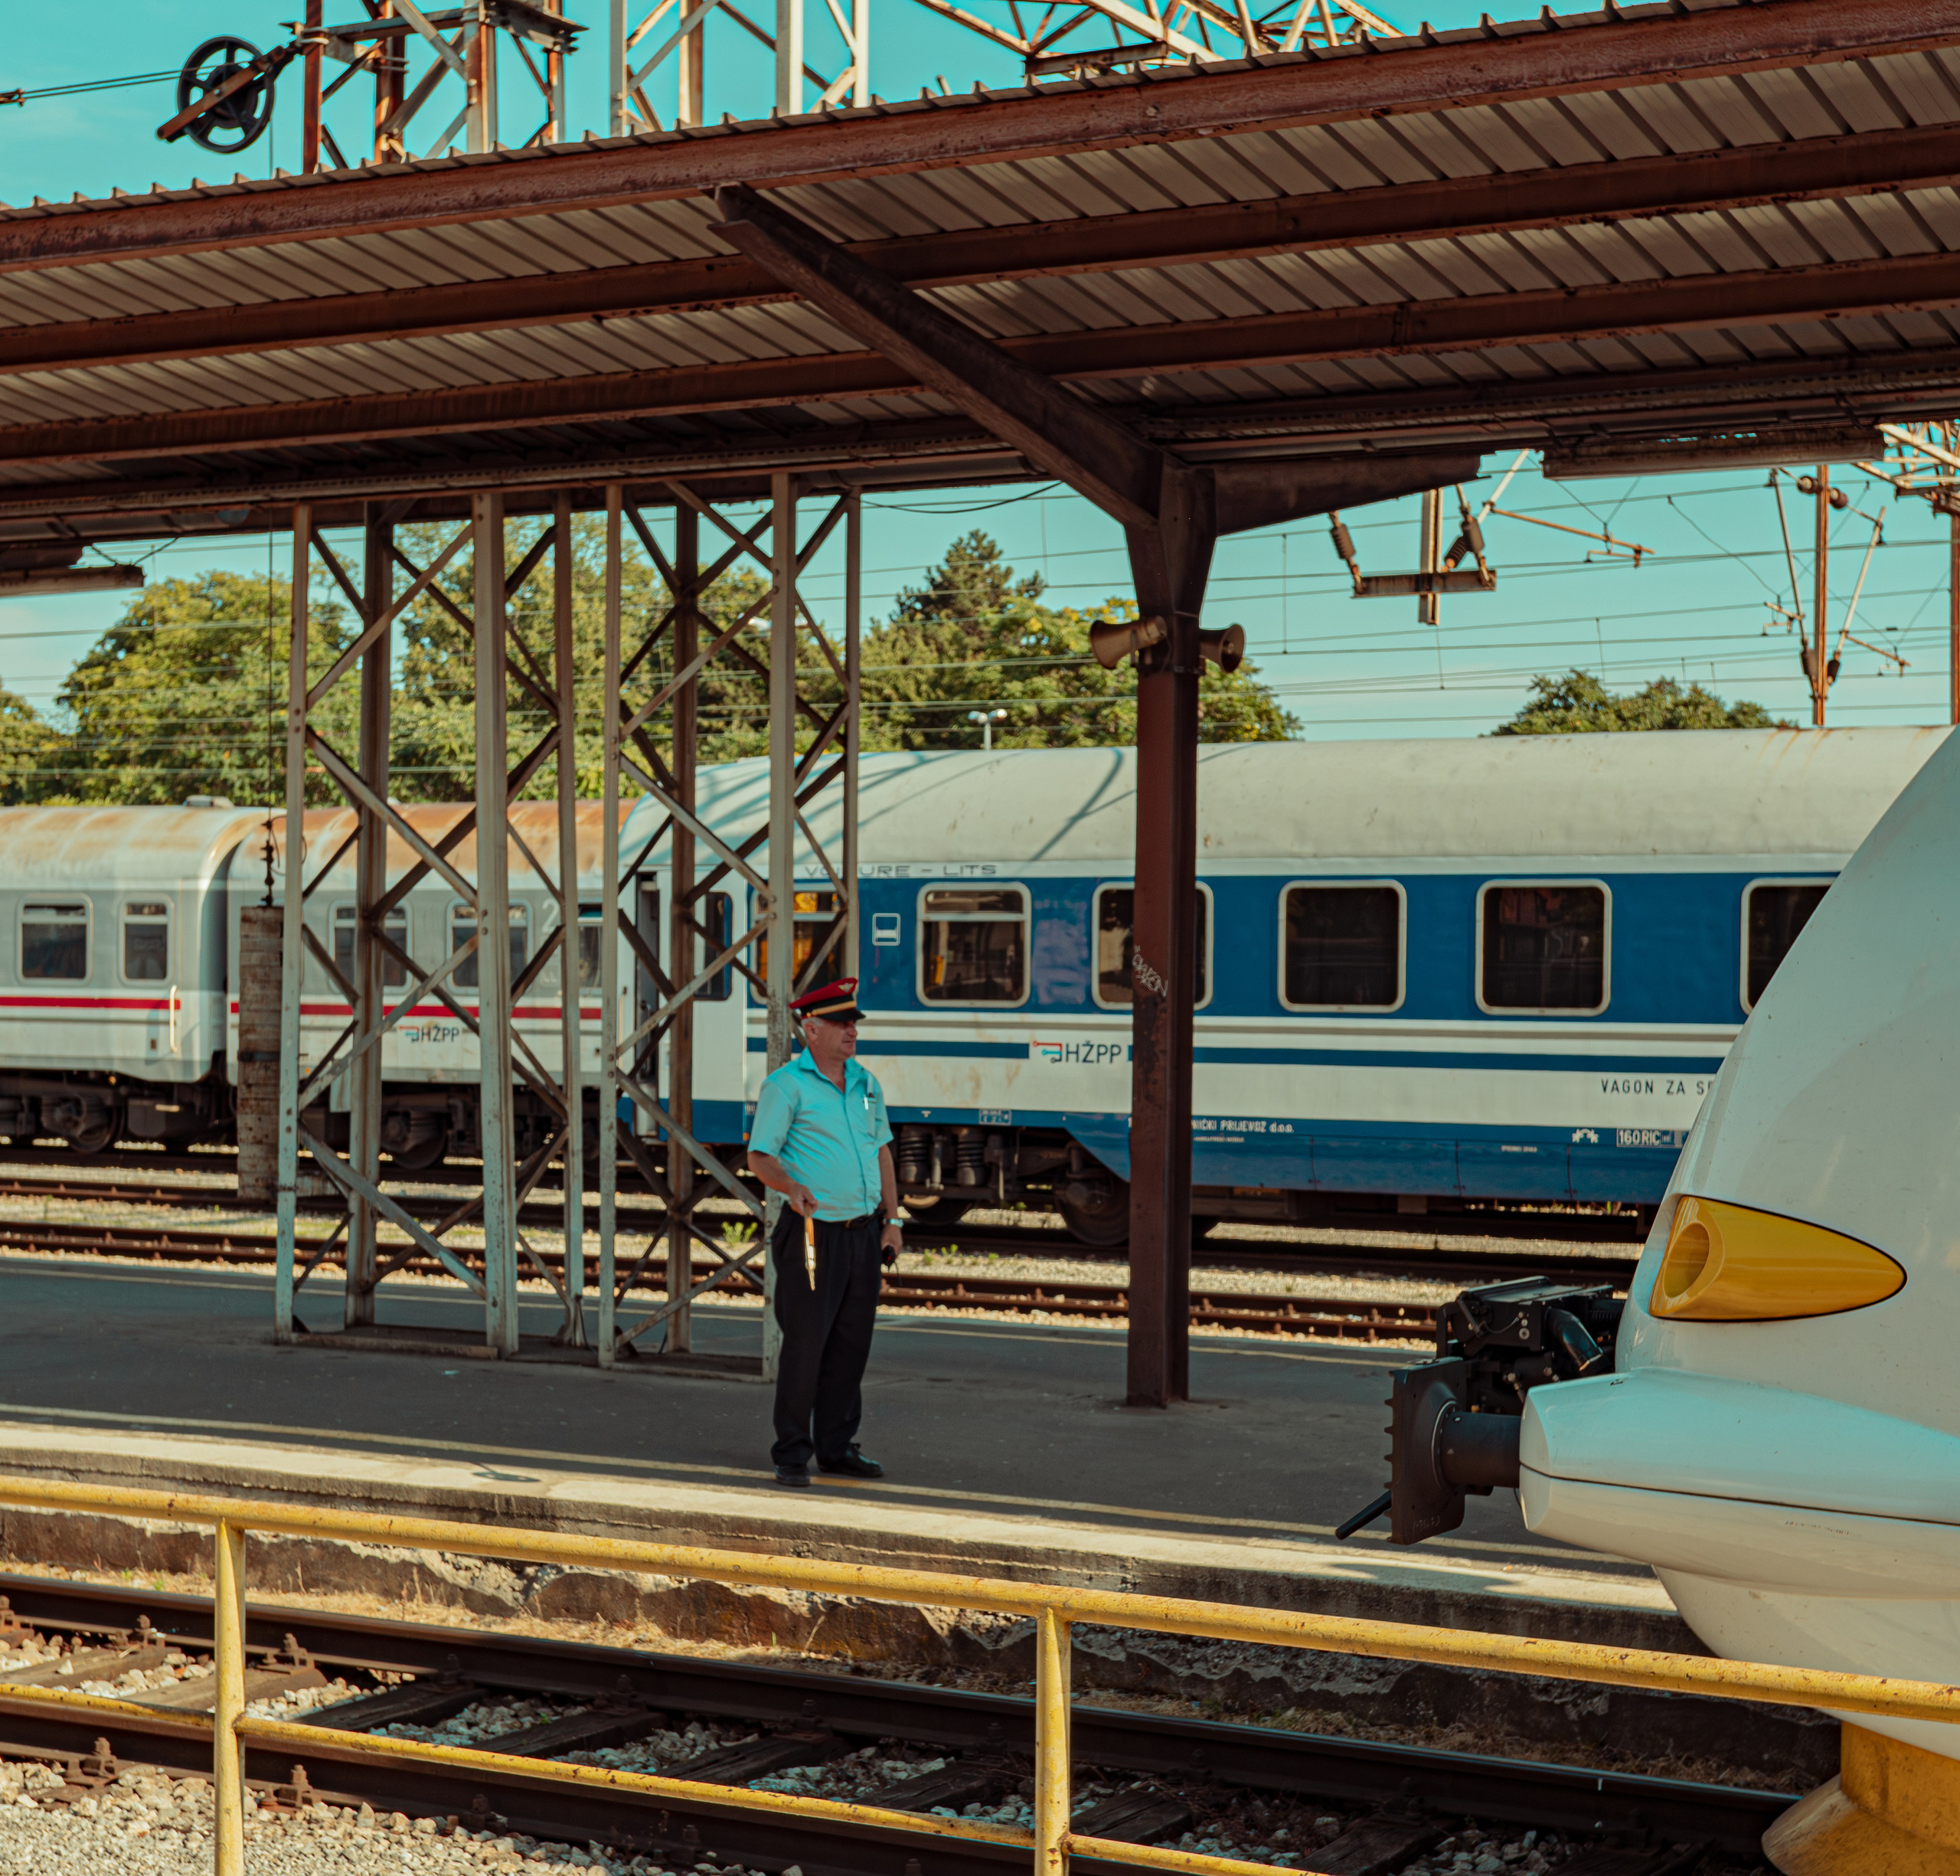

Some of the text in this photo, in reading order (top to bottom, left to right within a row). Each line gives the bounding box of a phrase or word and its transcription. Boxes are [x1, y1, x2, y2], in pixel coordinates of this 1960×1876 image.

[805, 865, 910, 878] VOIURE
[943, 864, 997, 876] LITS
[541, 897, 560, 933] 2
[1066, 1040, 1122, 1064] HŽPP
[1601, 1079, 1654, 1094] VAGON
[1666, 1079, 1685, 1095] ZA
[1191, 1118, 1217, 1131] NIČKI
[1220, 1119, 1266, 1132] PRIJEVOZ
